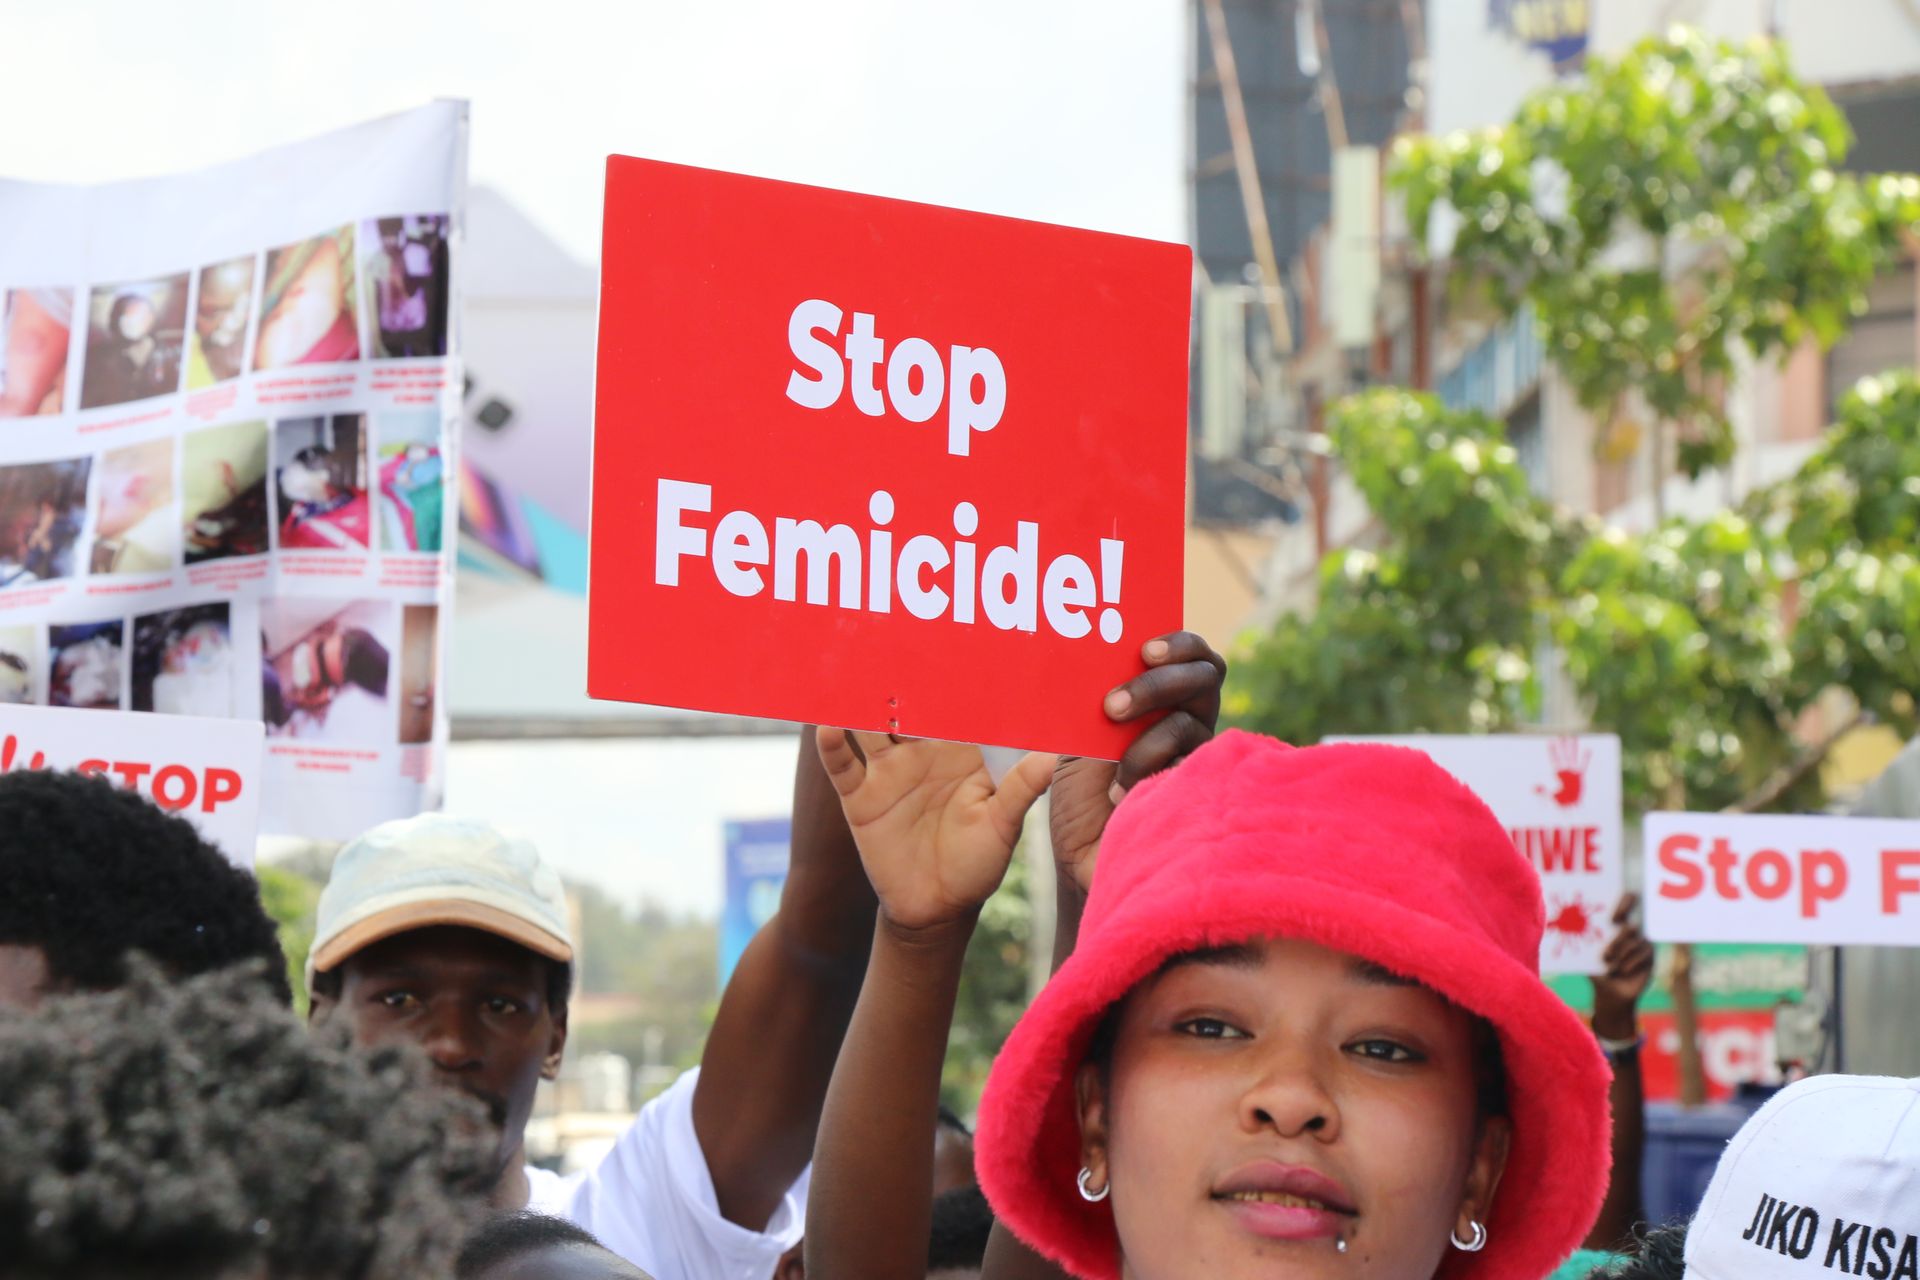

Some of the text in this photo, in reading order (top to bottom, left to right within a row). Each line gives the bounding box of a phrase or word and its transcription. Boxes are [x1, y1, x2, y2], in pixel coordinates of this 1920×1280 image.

[785, 298, 1007, 457] Stop
[654, 477, 1125, 644] Femicide!
[1658, 833, 1849, 919] Stop
[1742, 1192, 1920, 1280] JIKO KISA
